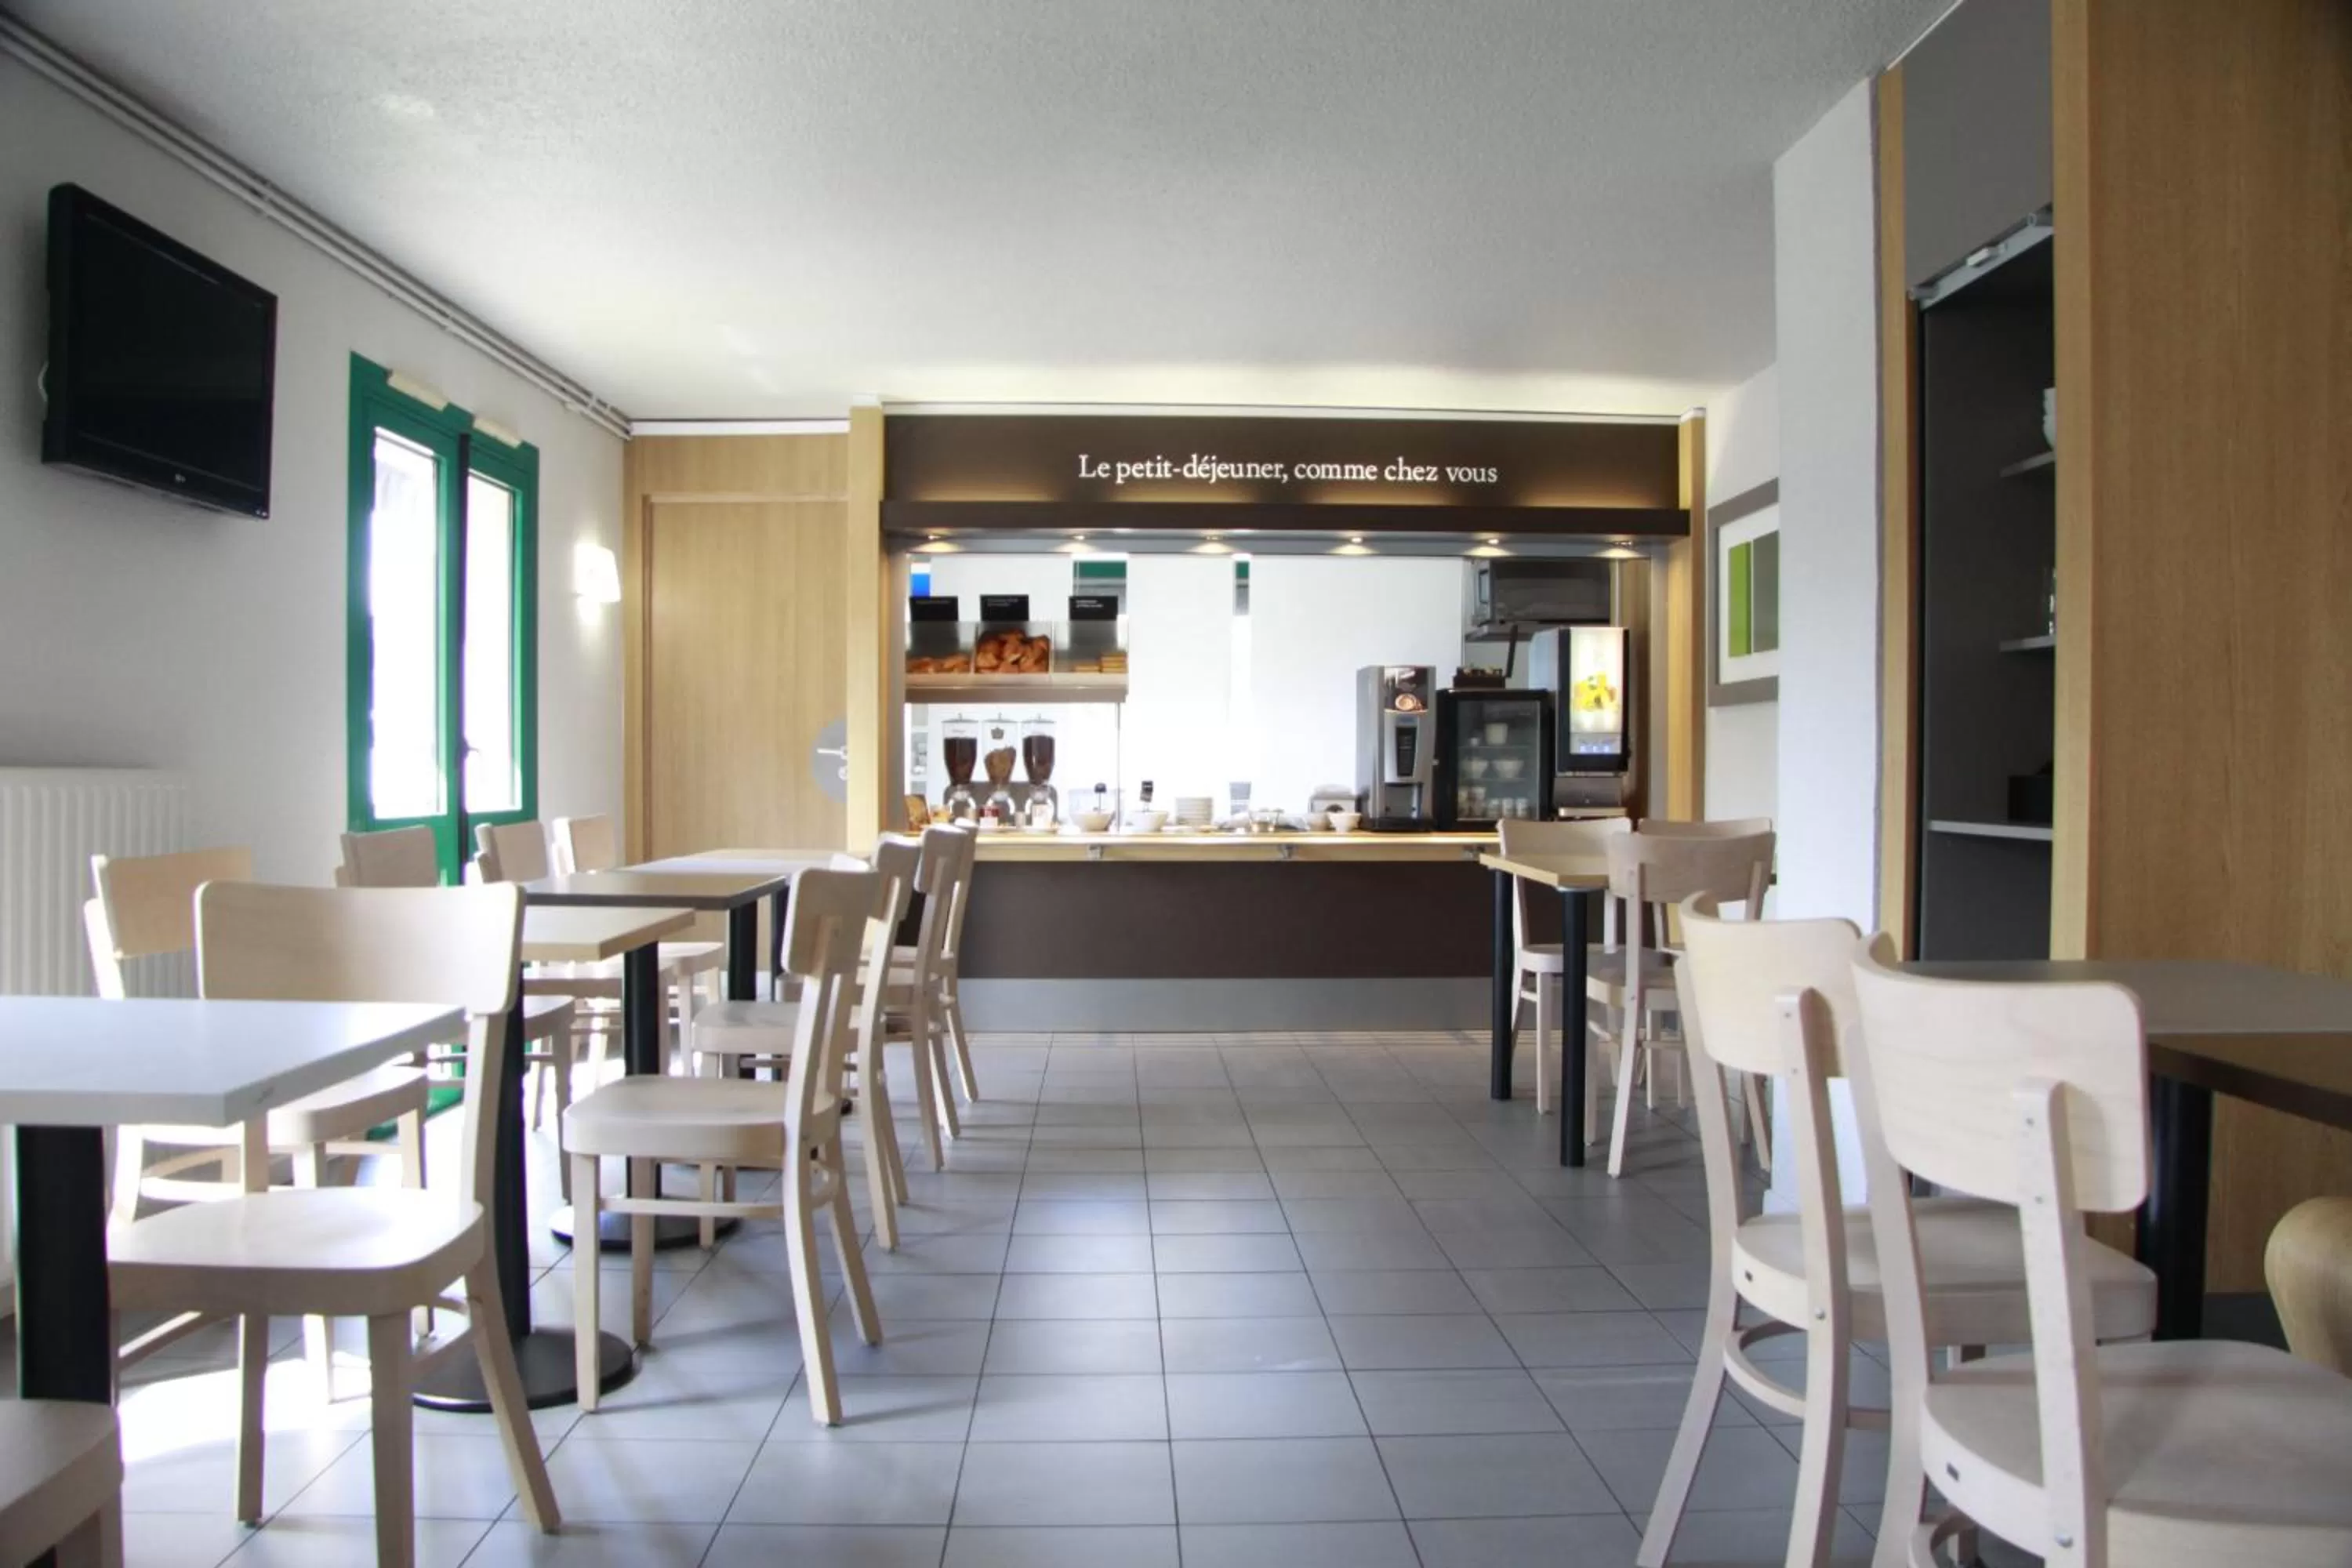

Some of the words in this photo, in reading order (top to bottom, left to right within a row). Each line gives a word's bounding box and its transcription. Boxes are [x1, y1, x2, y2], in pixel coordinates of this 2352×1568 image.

[1078, 454, 1111, 478] Le
[1116, 452, 1289, 485] petit-déjeuner,
[1294, 463, 1378, 481] comme
[1384, 456, 1439, 481] chez
[1445, 466, 1498, 483] vous
